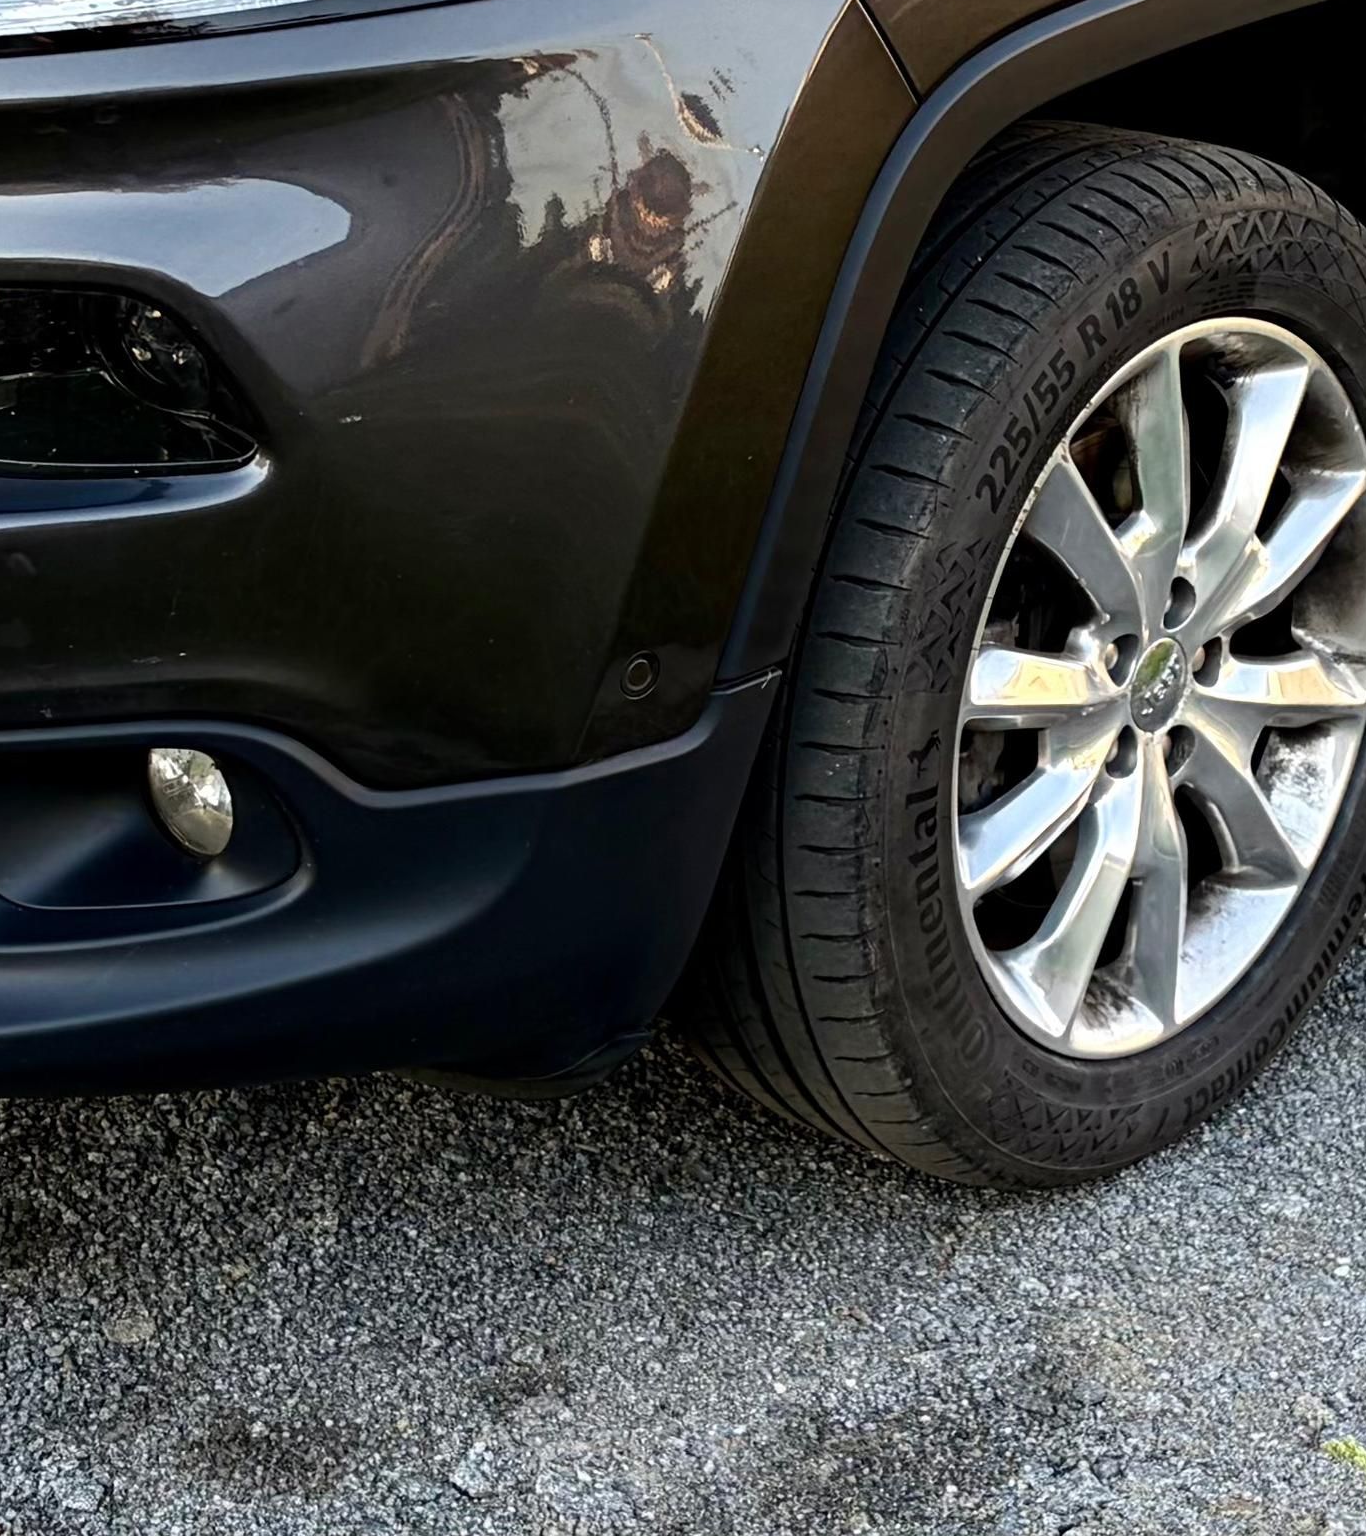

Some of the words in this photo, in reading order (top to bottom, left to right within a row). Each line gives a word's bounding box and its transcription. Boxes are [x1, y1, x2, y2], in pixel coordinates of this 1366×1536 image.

[975, 348, 1076, 514] 225/55
[1076, 313, 1108, 358] R
[1105, 276, 1143, 331] 18
[1147, 250, 1171, 295] V
